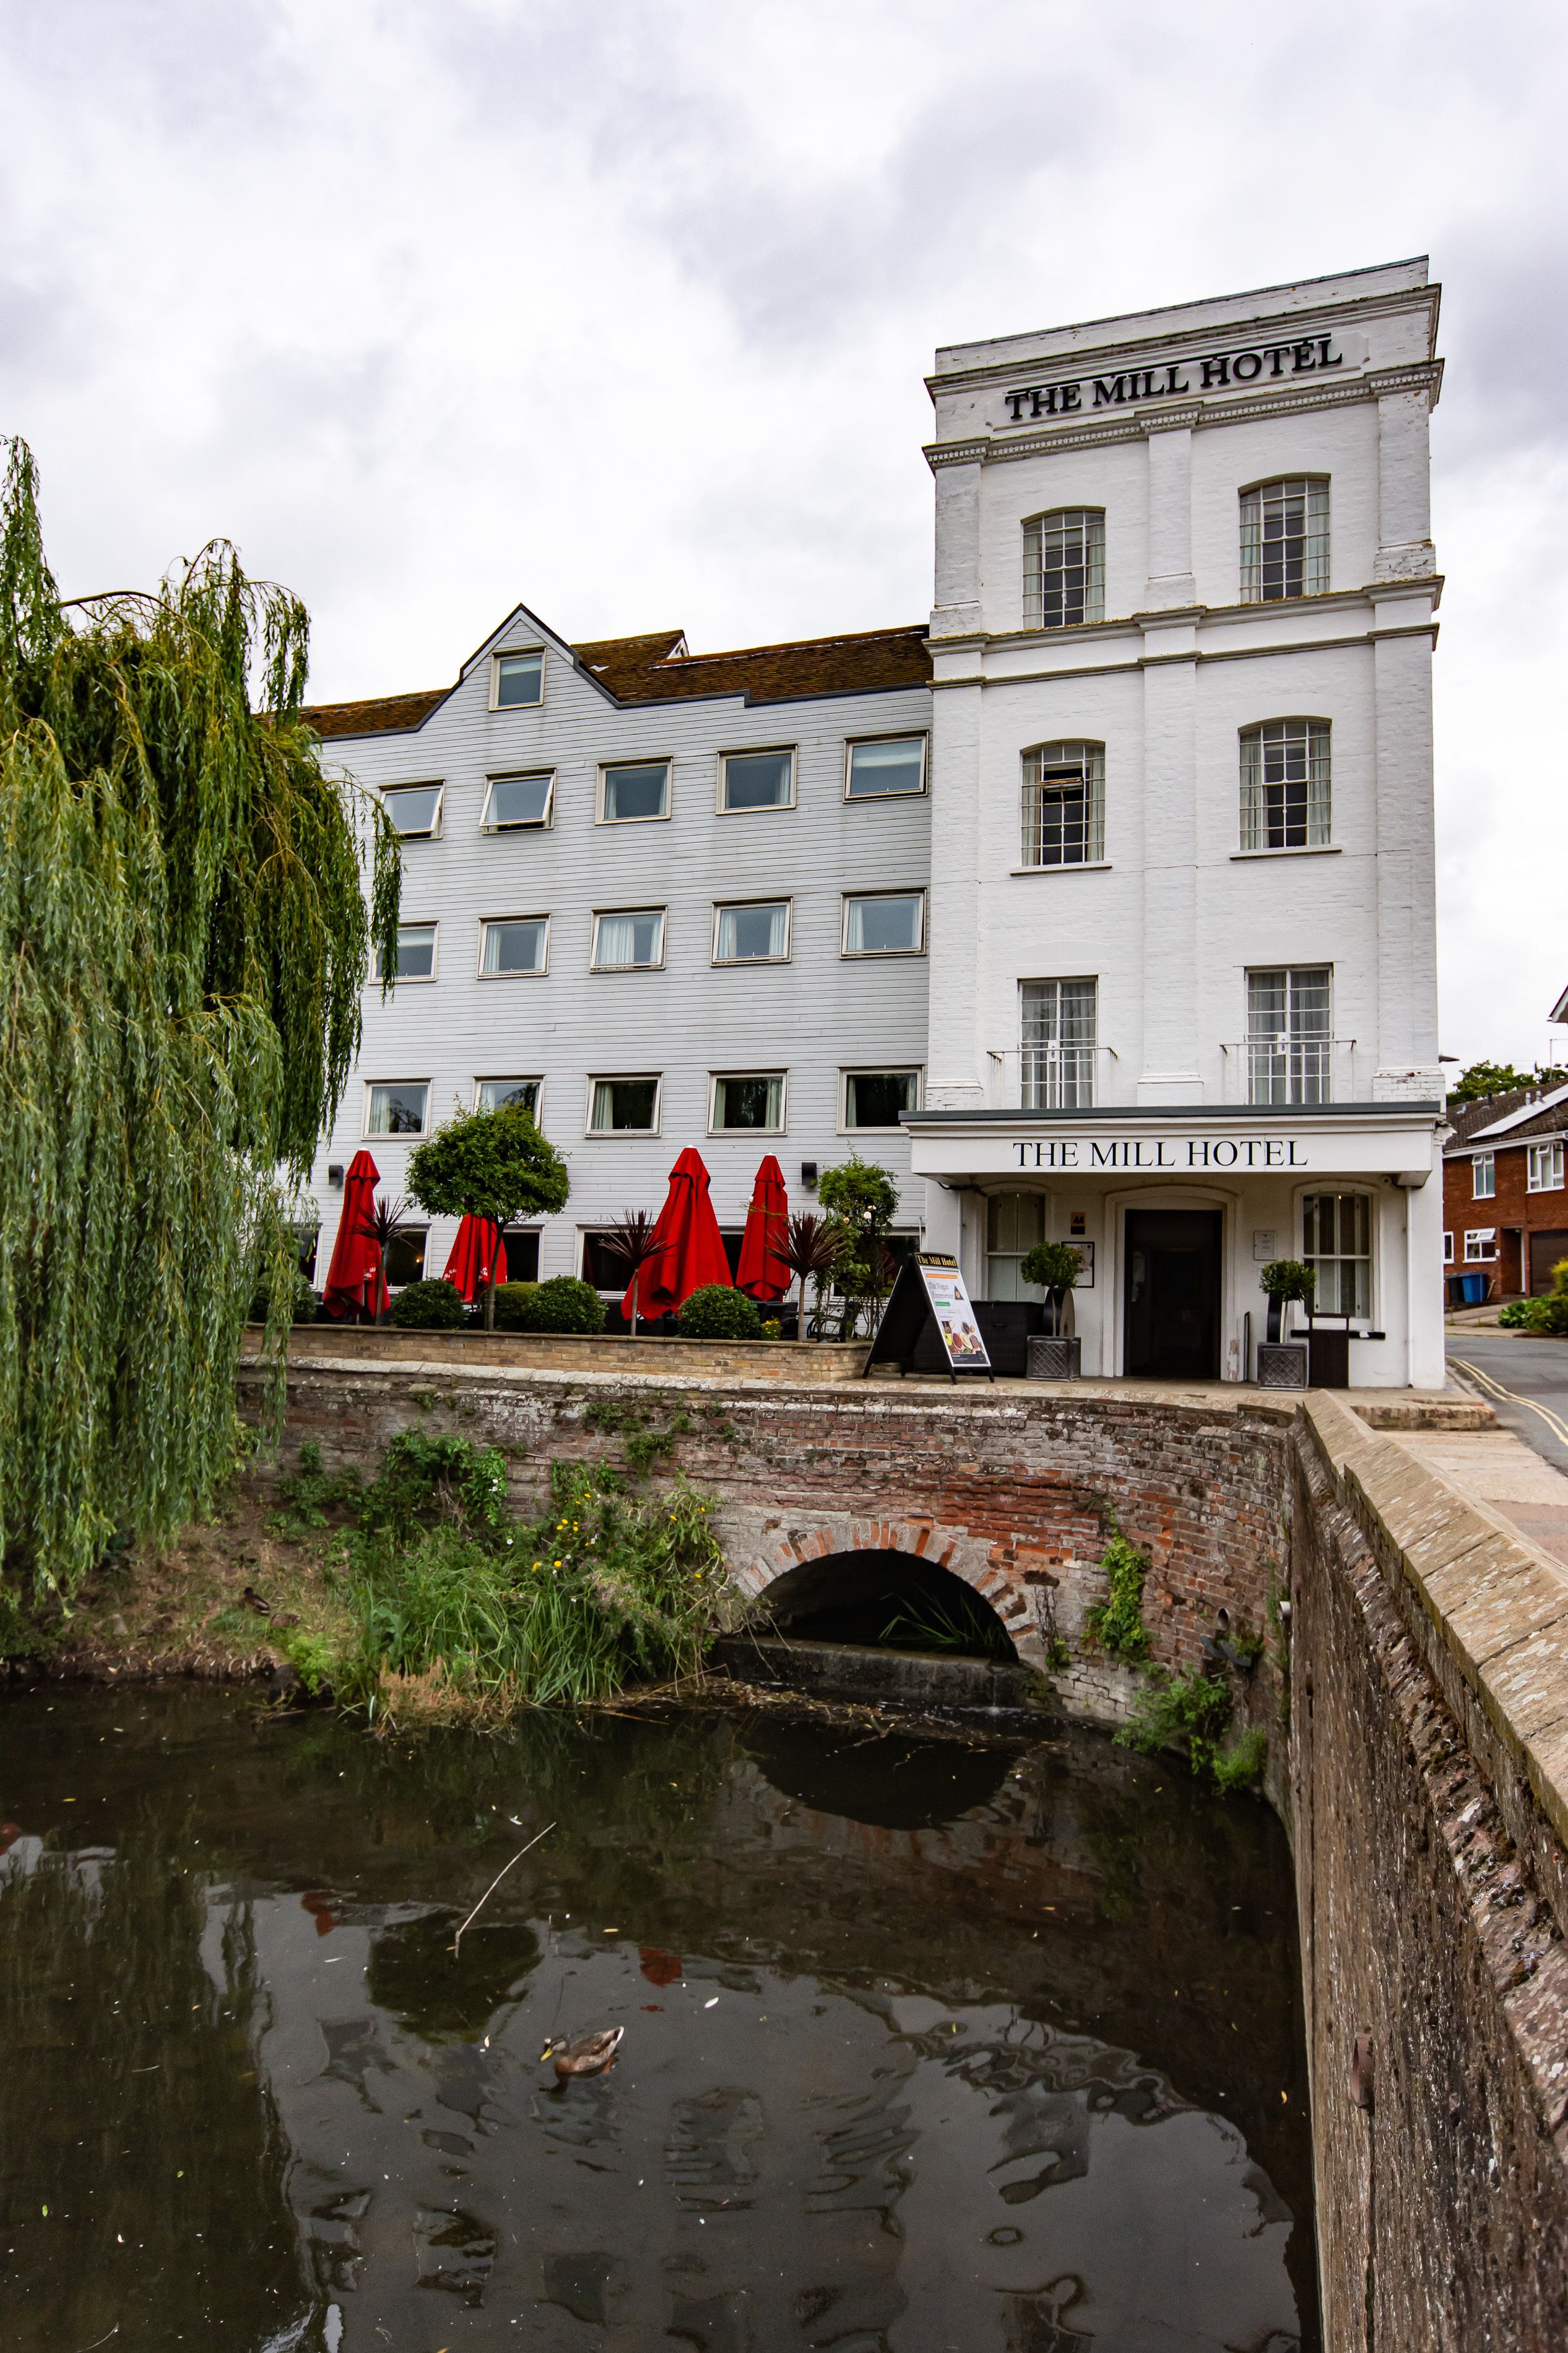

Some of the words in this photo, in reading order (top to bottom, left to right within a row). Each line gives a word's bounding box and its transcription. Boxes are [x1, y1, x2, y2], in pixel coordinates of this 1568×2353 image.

[1004, 383, 1082, 419] THE
[1092, 367, 1189, 406] MILL
[1200, 339, 1343, 387] HOTEL
[1013, 1142, 1079, 1167] THE
[1089, 1142, 1176, 1167] MILL
[1185, 1141, 1309, 1167] HOTEL
[916, 1255, 929, 1264] The
[929, 1256, 941, 1265] Mill
[941, 1257, 956, 1266] Hotel
